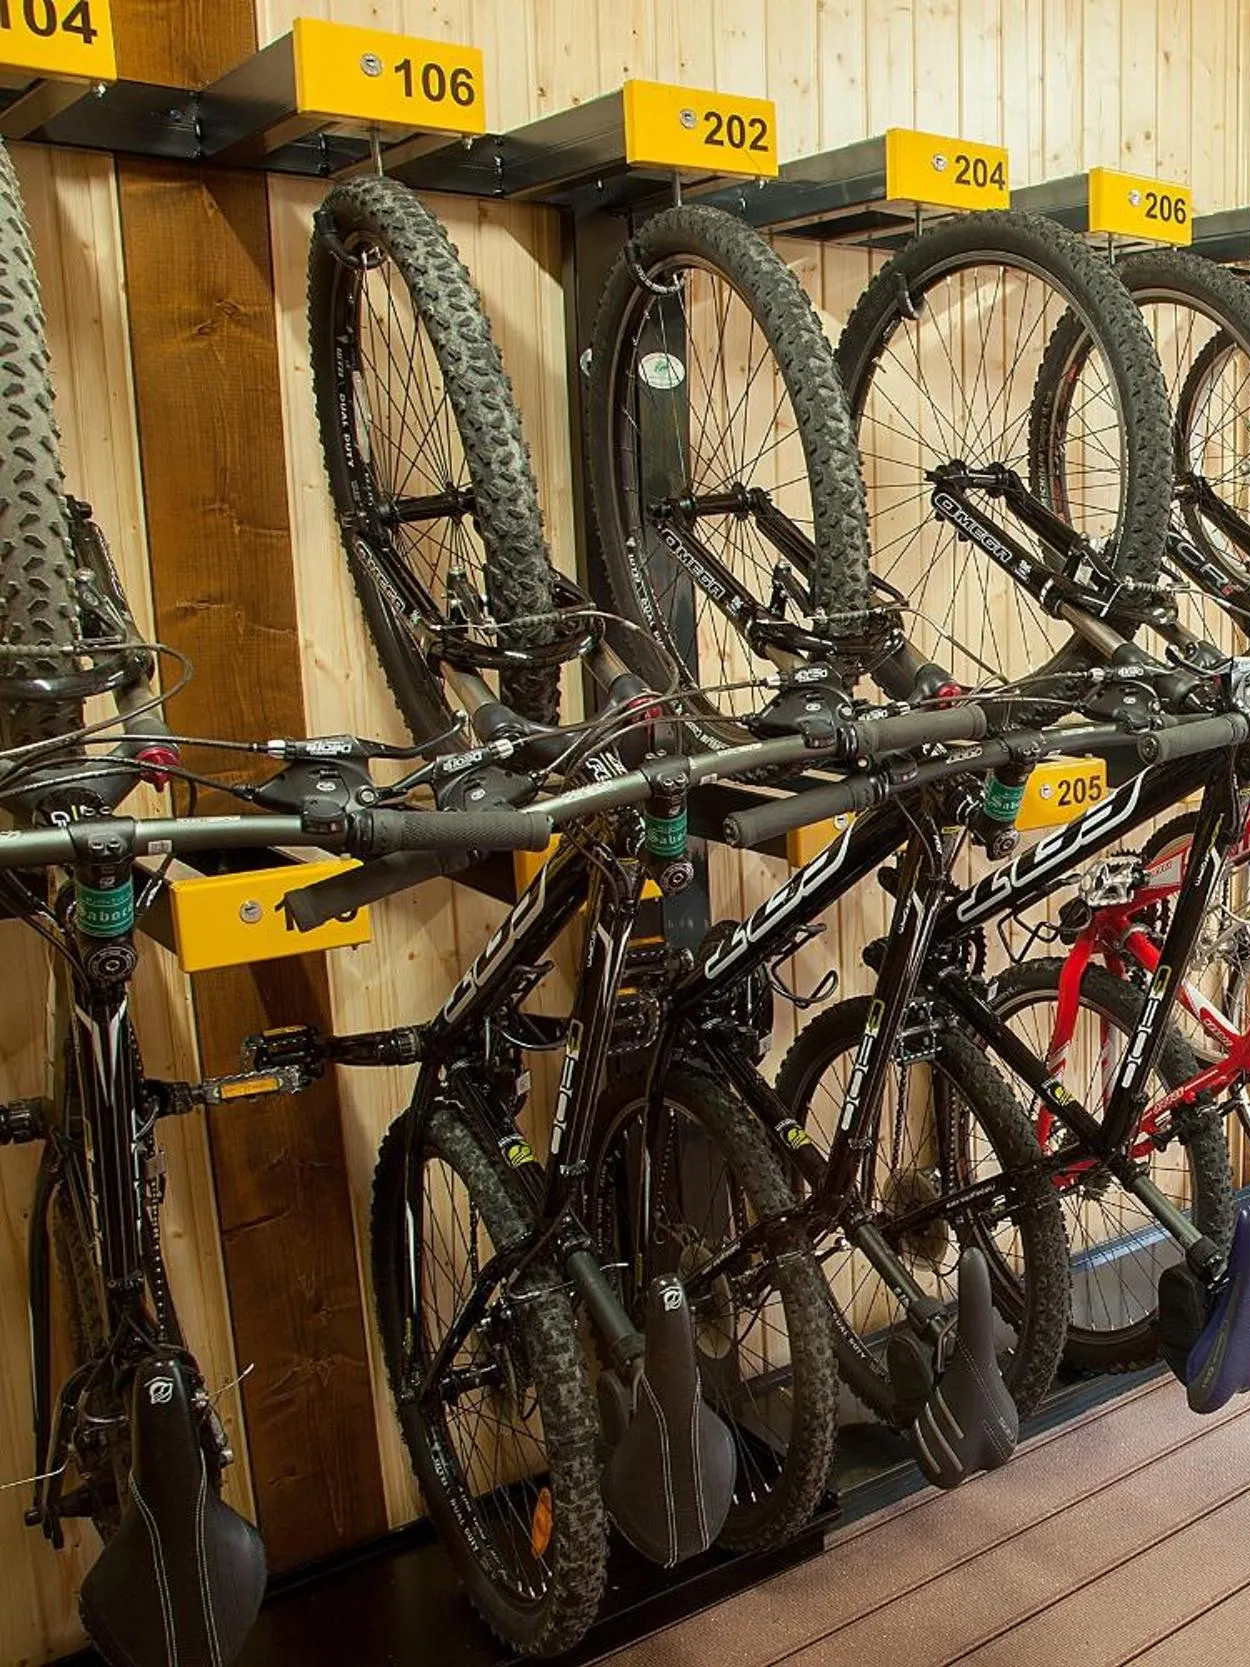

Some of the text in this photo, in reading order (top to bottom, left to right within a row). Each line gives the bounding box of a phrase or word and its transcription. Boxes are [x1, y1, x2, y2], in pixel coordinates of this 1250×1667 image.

[394, 58, 475, 107] 106
[703, 111, 769, 152] 202
[955, 154, 1006, 191] 204
[1145, 192, 1187, 225] 206
[1057, 775, 1103, 808] 205
